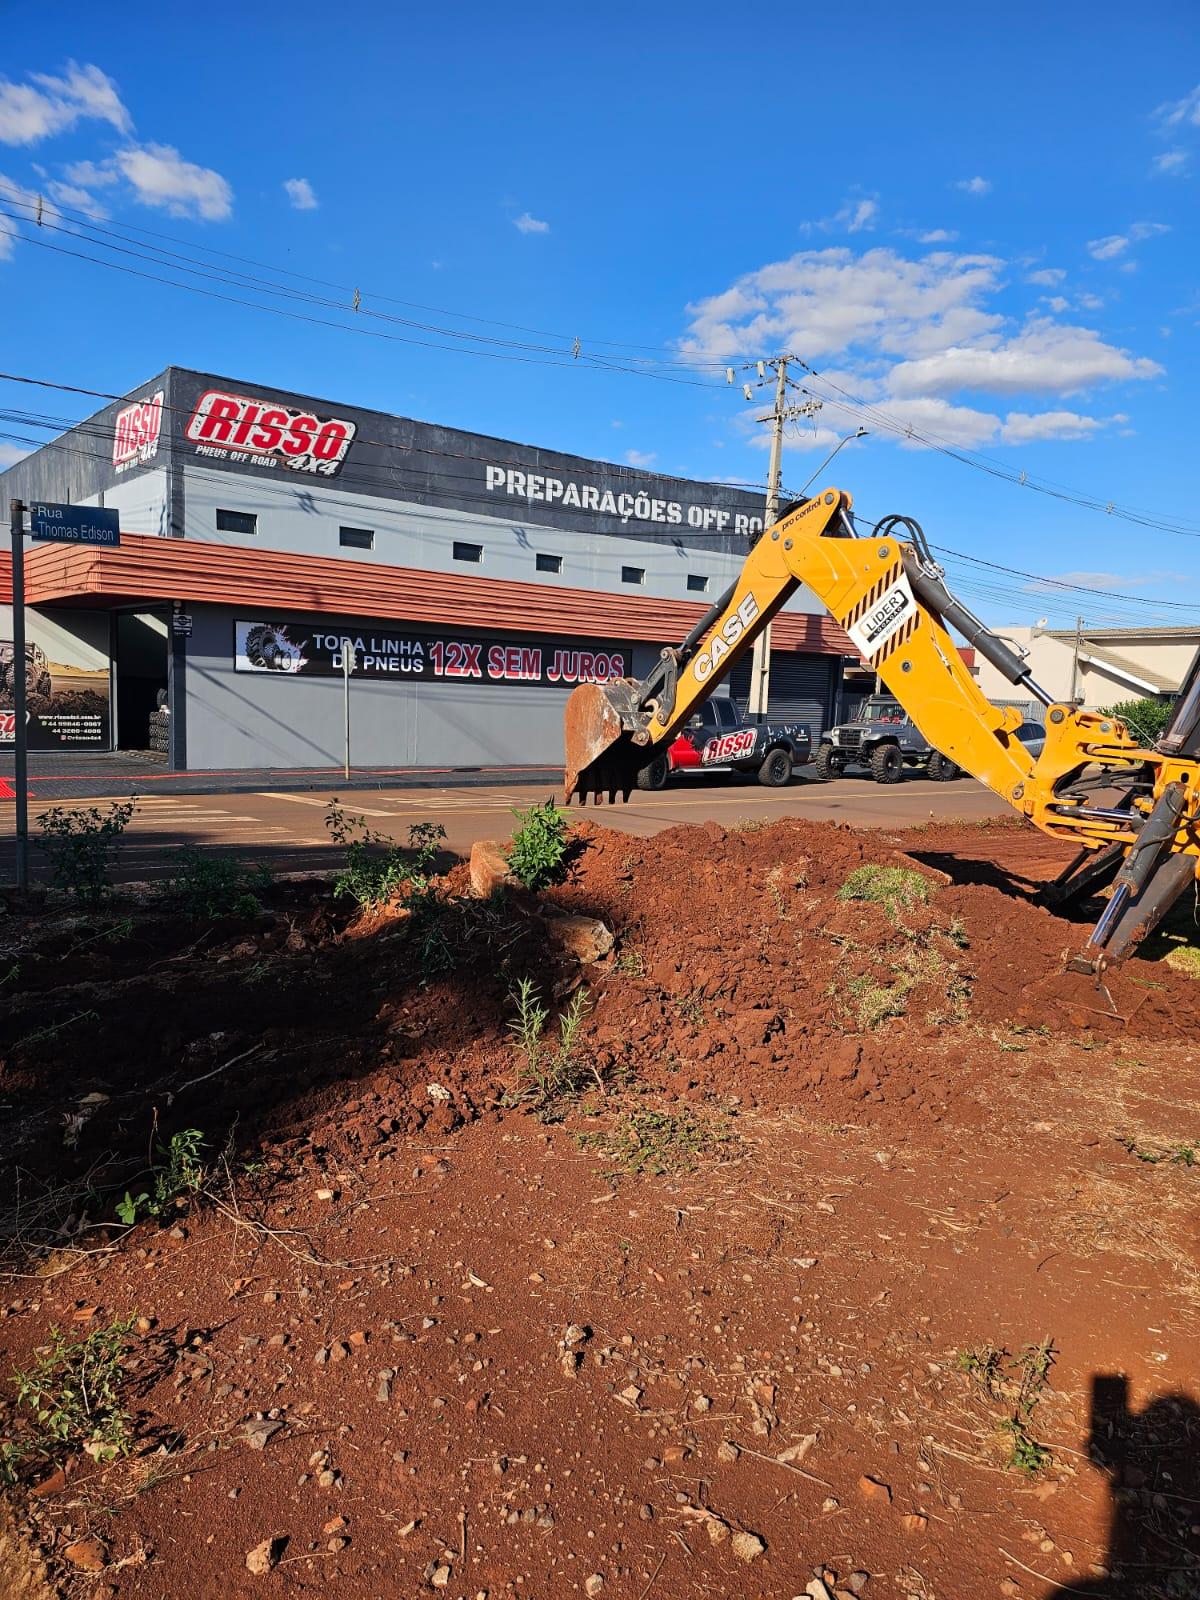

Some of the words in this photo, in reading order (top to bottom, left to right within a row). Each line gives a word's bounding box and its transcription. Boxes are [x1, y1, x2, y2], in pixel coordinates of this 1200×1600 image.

[115, 398, 161, 460] RISSO
[199, 398, 347, 460] RISSO
[195, 445, 228, 459] PNEUS
[230, 450, 249, 463] OFF
[250, 454, 278, 468] ROAD
[286, 455, 339, 476] 4X4
[37, 505, 63, 519] Rua
[485, 465, 683, 524] PREPARAÇÕES
[687, 505, 730, 532] OFF
[735, 513, 763, 535] RO
[781, 518, 795, 532] pro
[795, 497, 822, 521] control
[37, 521, 79, 539] Thomas
[80, 525, 114, 541] Edison
[313, 634, 367, 652] TODA
[370, 638, 424, 656] LINHA
[693, 591, 760, 683] CASE
[363, 655, 424, 673] PNEUS
[429, 640, 482, 678] 12X
[487, 644, 541, 681] SEM
[547, 649, 624, 685] JUROS
[708, 732, 754, 759] RISSO
